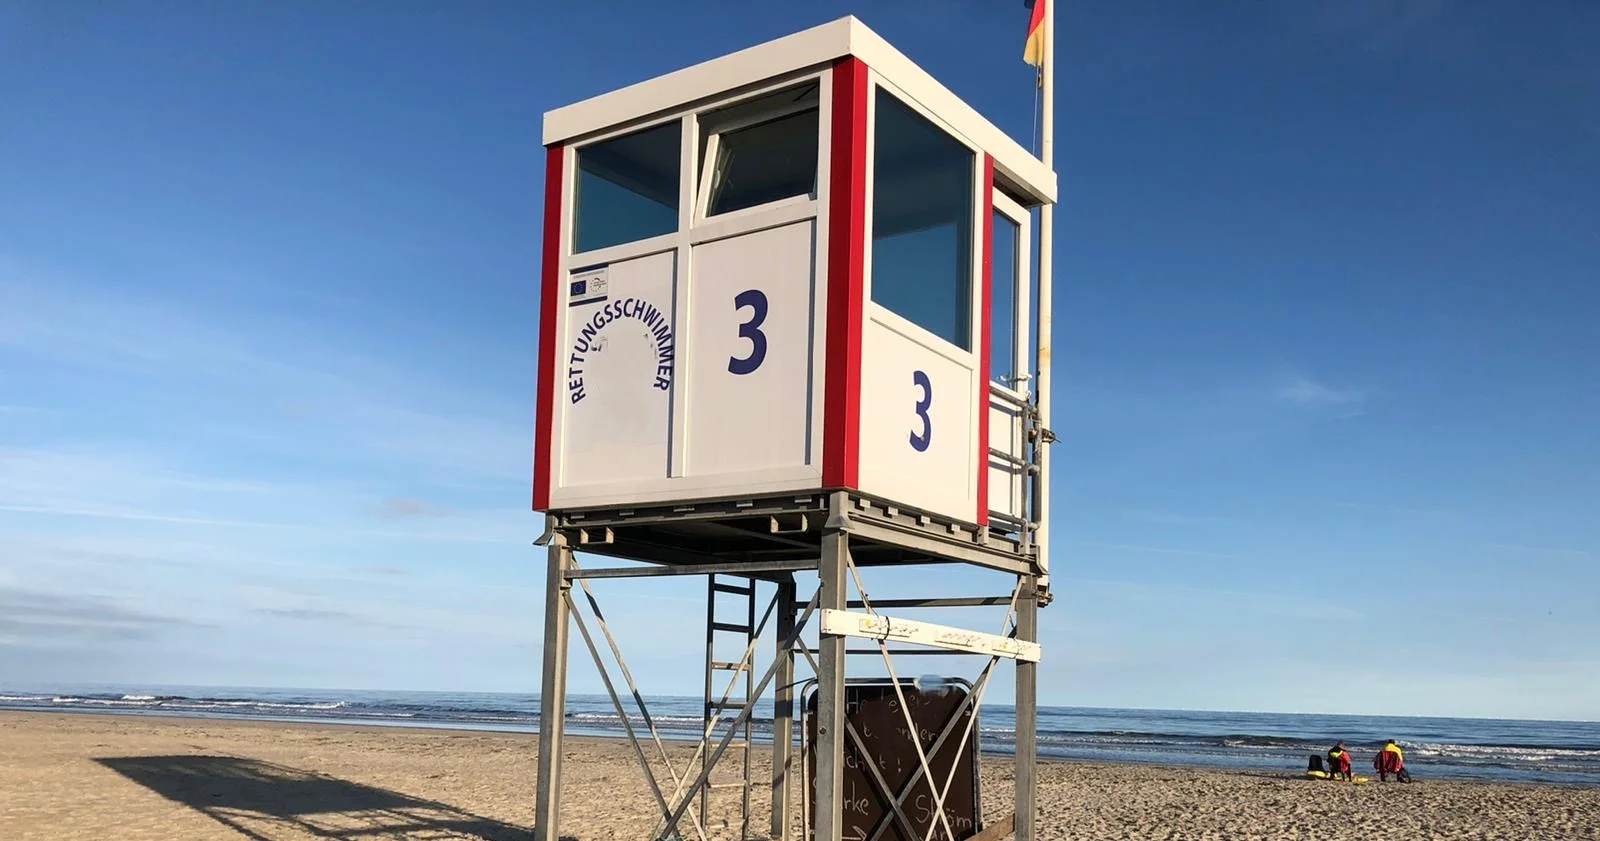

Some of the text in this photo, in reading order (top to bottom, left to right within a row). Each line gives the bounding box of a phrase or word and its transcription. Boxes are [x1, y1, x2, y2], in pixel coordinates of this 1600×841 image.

[568, 298, 675, 405] RETTUNGSSCHWIMMER
[728, 289, 768, 375] 3
[910, 370, 932, 452] 3
